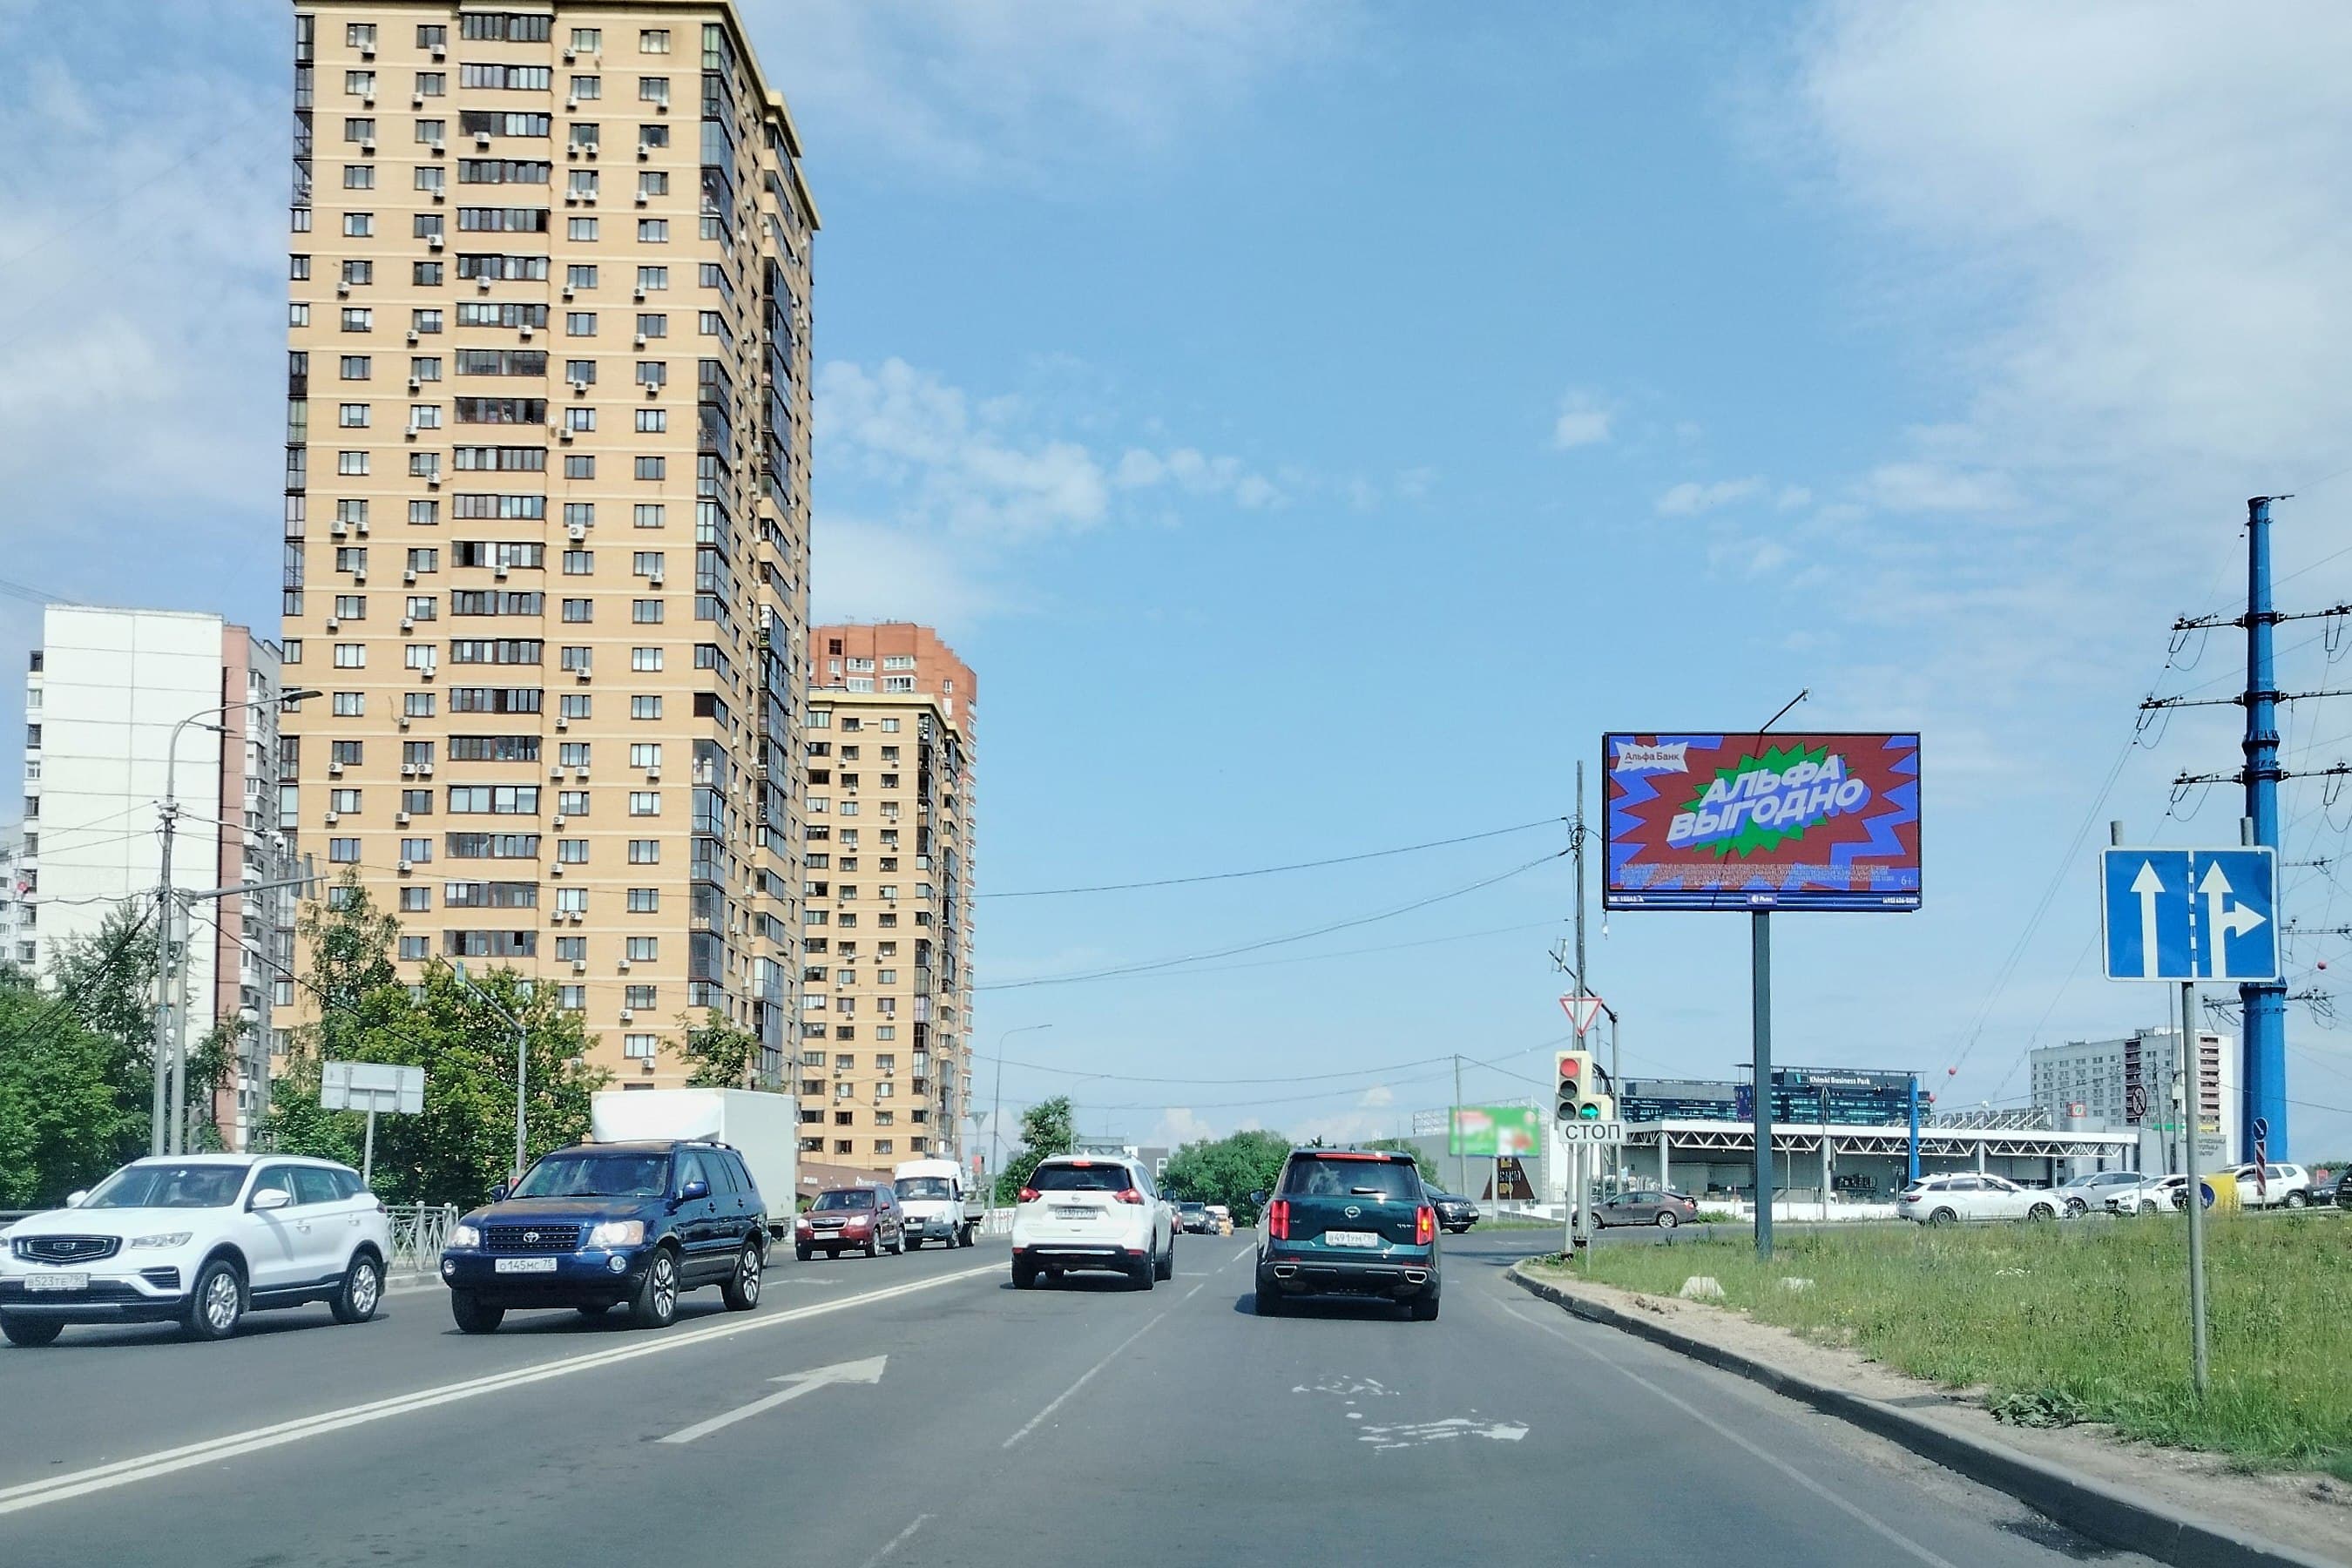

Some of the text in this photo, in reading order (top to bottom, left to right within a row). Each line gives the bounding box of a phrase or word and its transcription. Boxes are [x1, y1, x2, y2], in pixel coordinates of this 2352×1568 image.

[1625, 752, 1680, 763] Альфа Банк
[1699, 754, 1840, 807] АЛЬФА
[1666, 778, 1863, 841] ВЫГОДНО
[1565, 1124, 1620, 1139] СТОП
